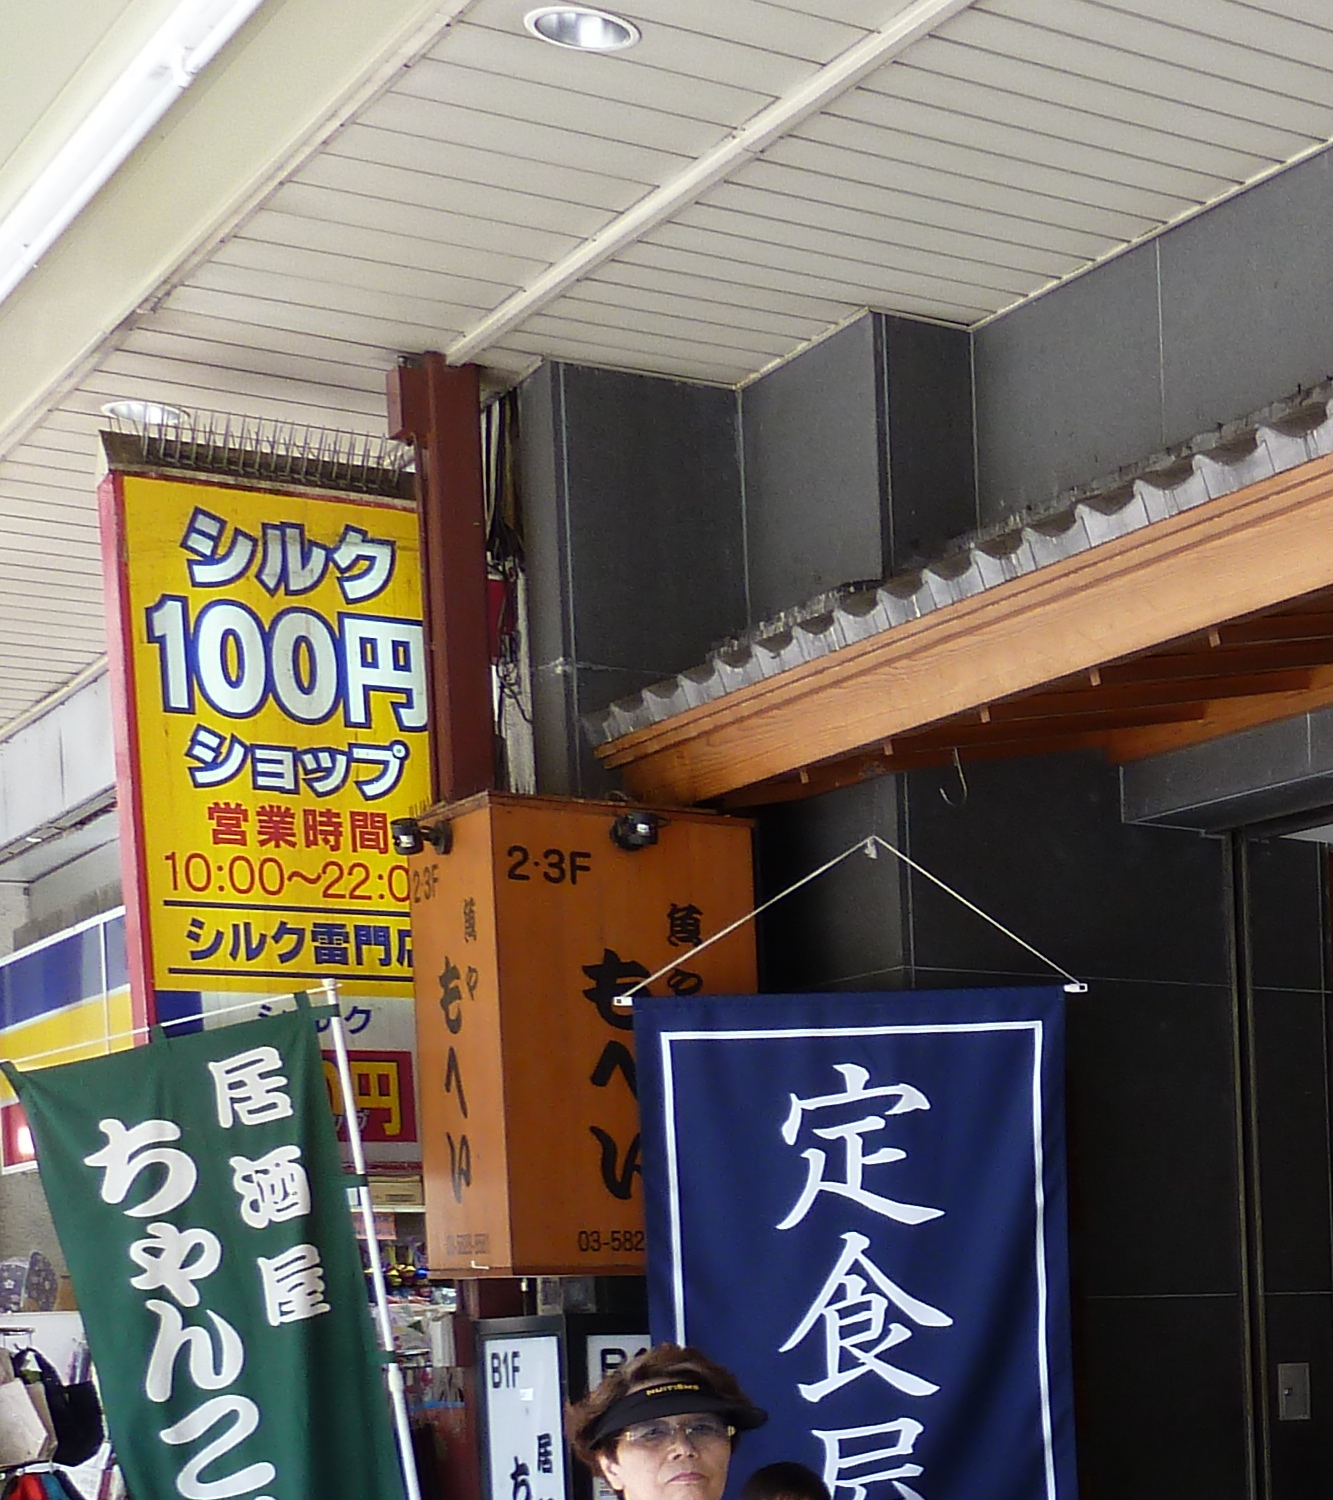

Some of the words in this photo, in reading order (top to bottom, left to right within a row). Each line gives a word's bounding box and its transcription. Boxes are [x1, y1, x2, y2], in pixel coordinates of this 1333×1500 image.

[181, 506, 394, 603] シルク
[144, 595, 430, 733] 100円
[185, 724, 408, 800] ショップ
[207, 800, 389, 855] 営業時間
[437, 955, 472, 1204] もへい
[207, 1045, 331, 1328] 居酒屋
[490, 1350, 521, 1390] B1F
